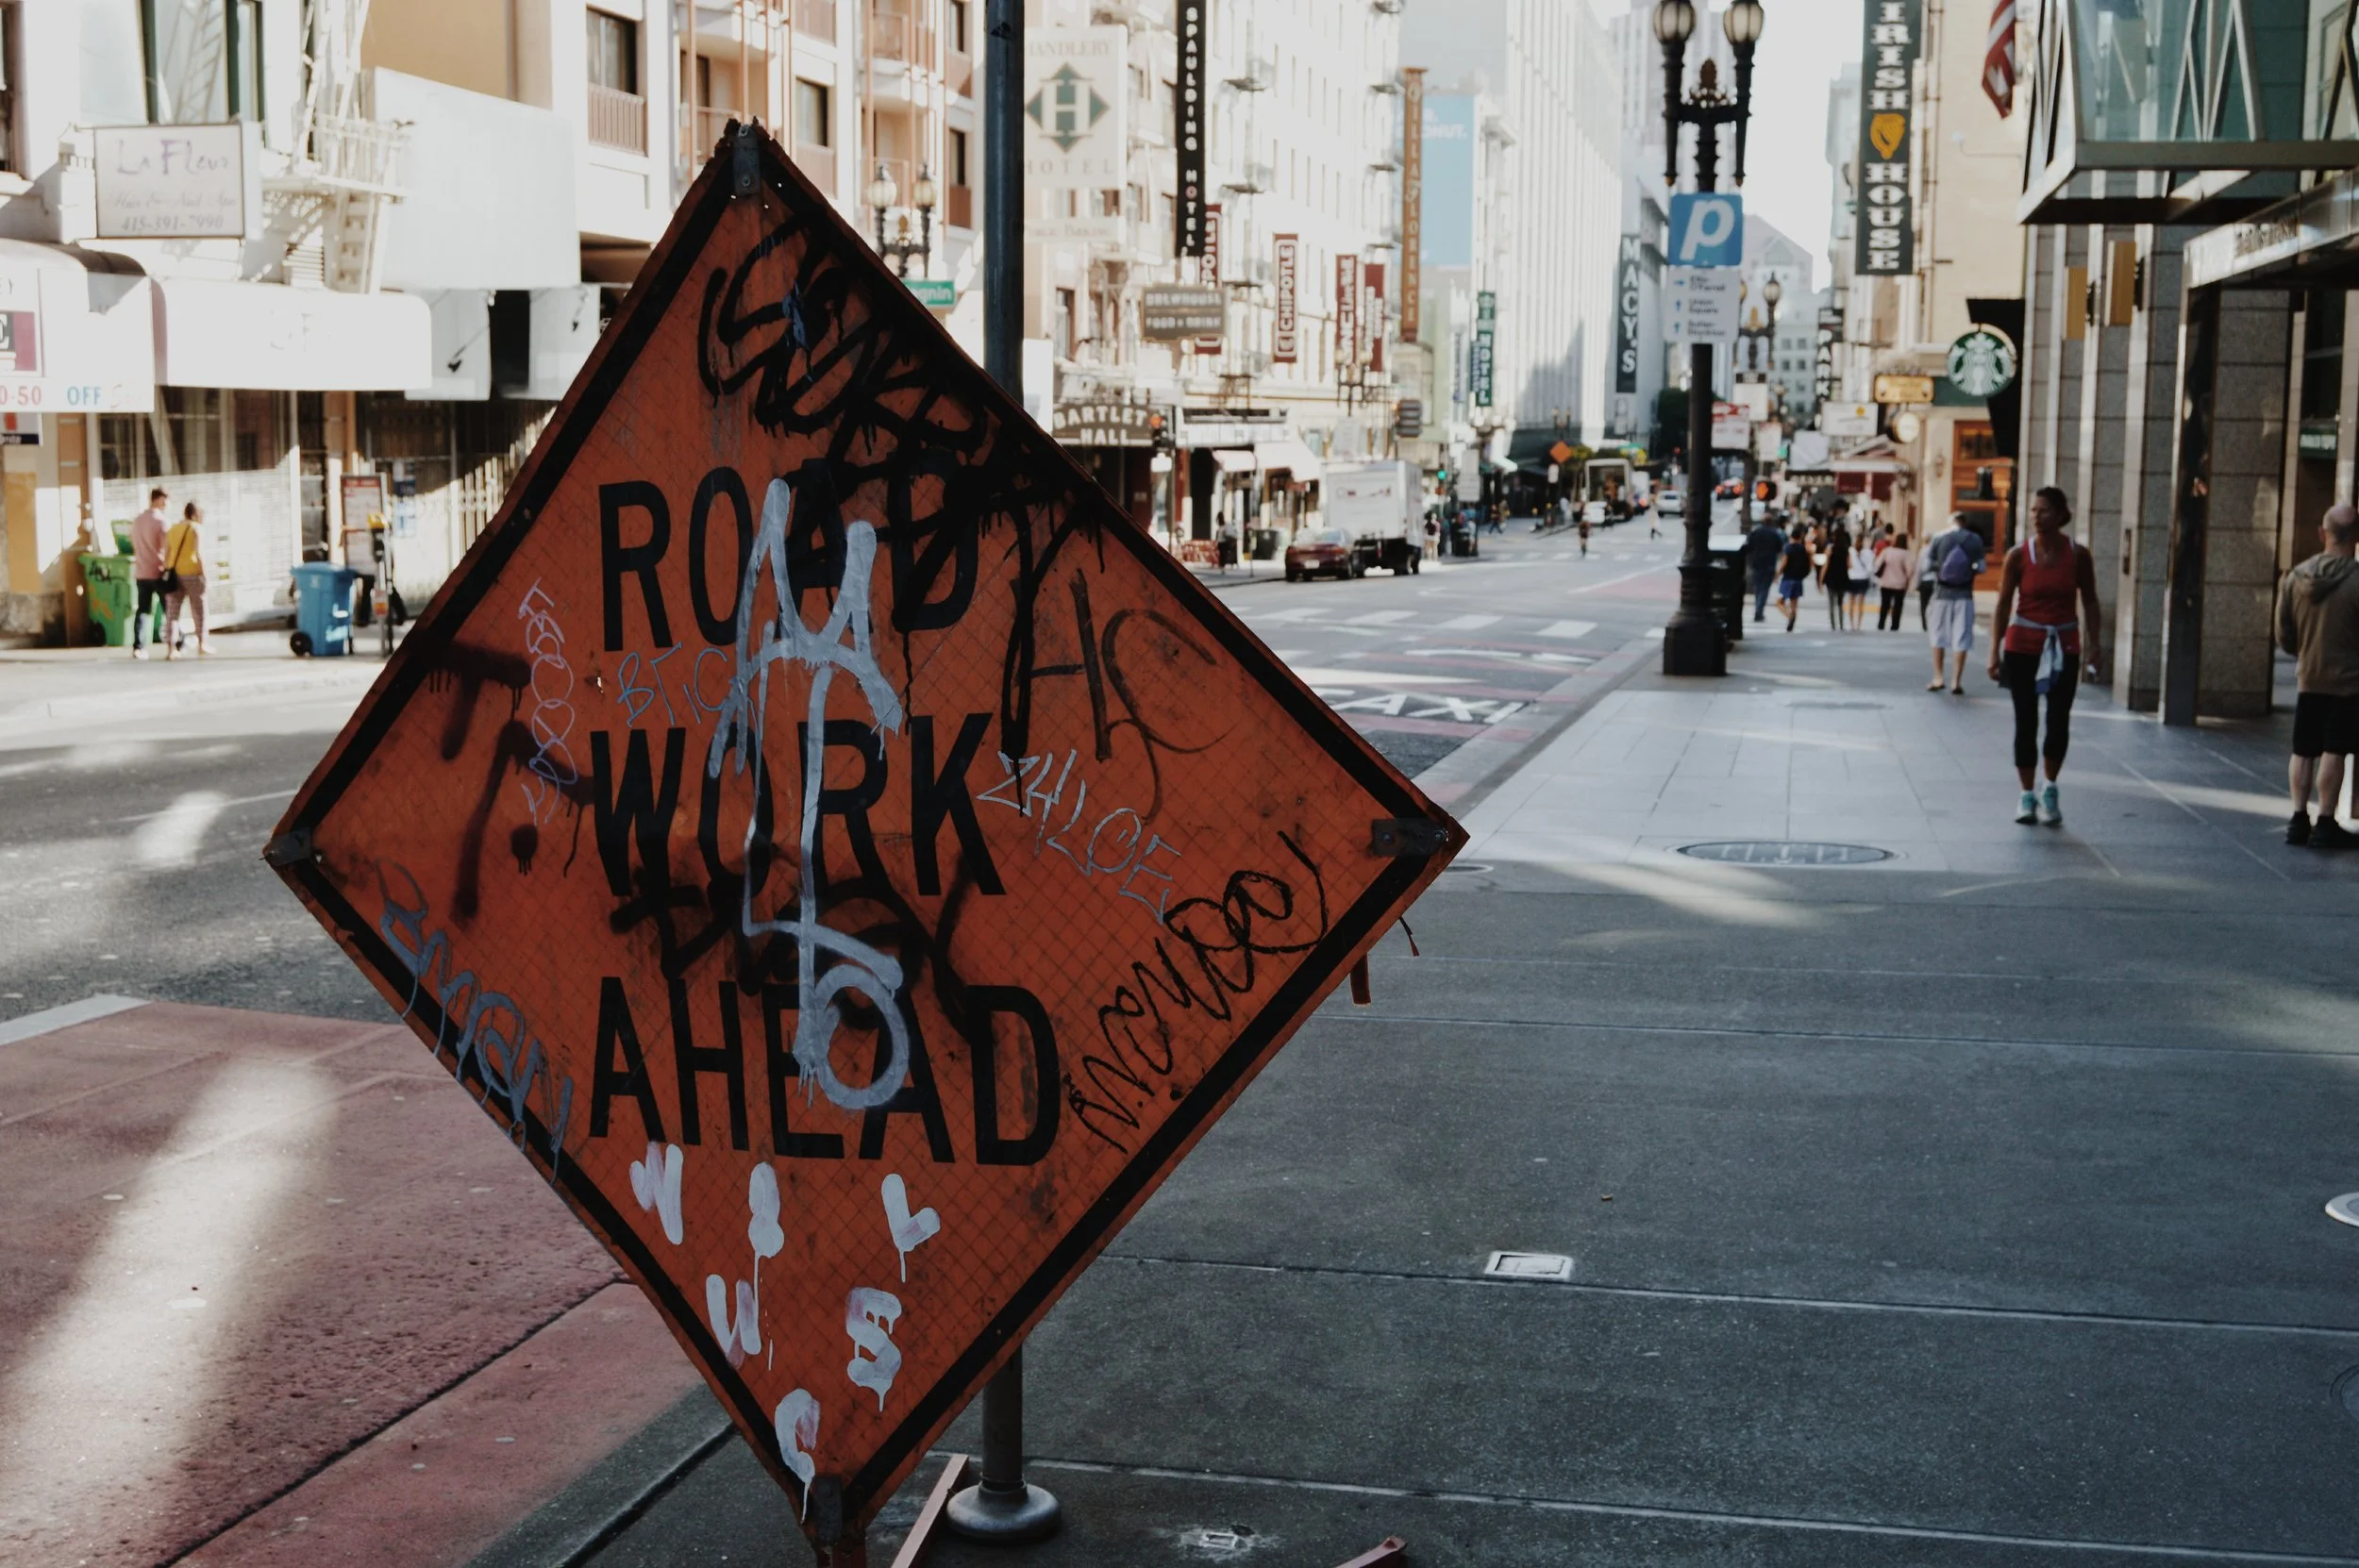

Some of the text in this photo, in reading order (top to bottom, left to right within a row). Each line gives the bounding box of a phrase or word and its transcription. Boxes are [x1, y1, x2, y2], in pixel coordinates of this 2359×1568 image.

[1185, 7, 1198, 151] SPAULDING
[1869, 2, 1913, 109] IRISH
[1185, 170, 1198, 247] HOTEL
[1865, 162, 1907, 270] HOUSE
[1279, 245, 1295, 331] CHIPOTLE
[1053, 406, 1148, 429] BARTLET
[1079, 428, 1130, 445] HALL
[598, 459, 979, 651] ROAD
[590, 712, 1007, 897] WORK
[589, 976, 1061, 1167] AHEAD
